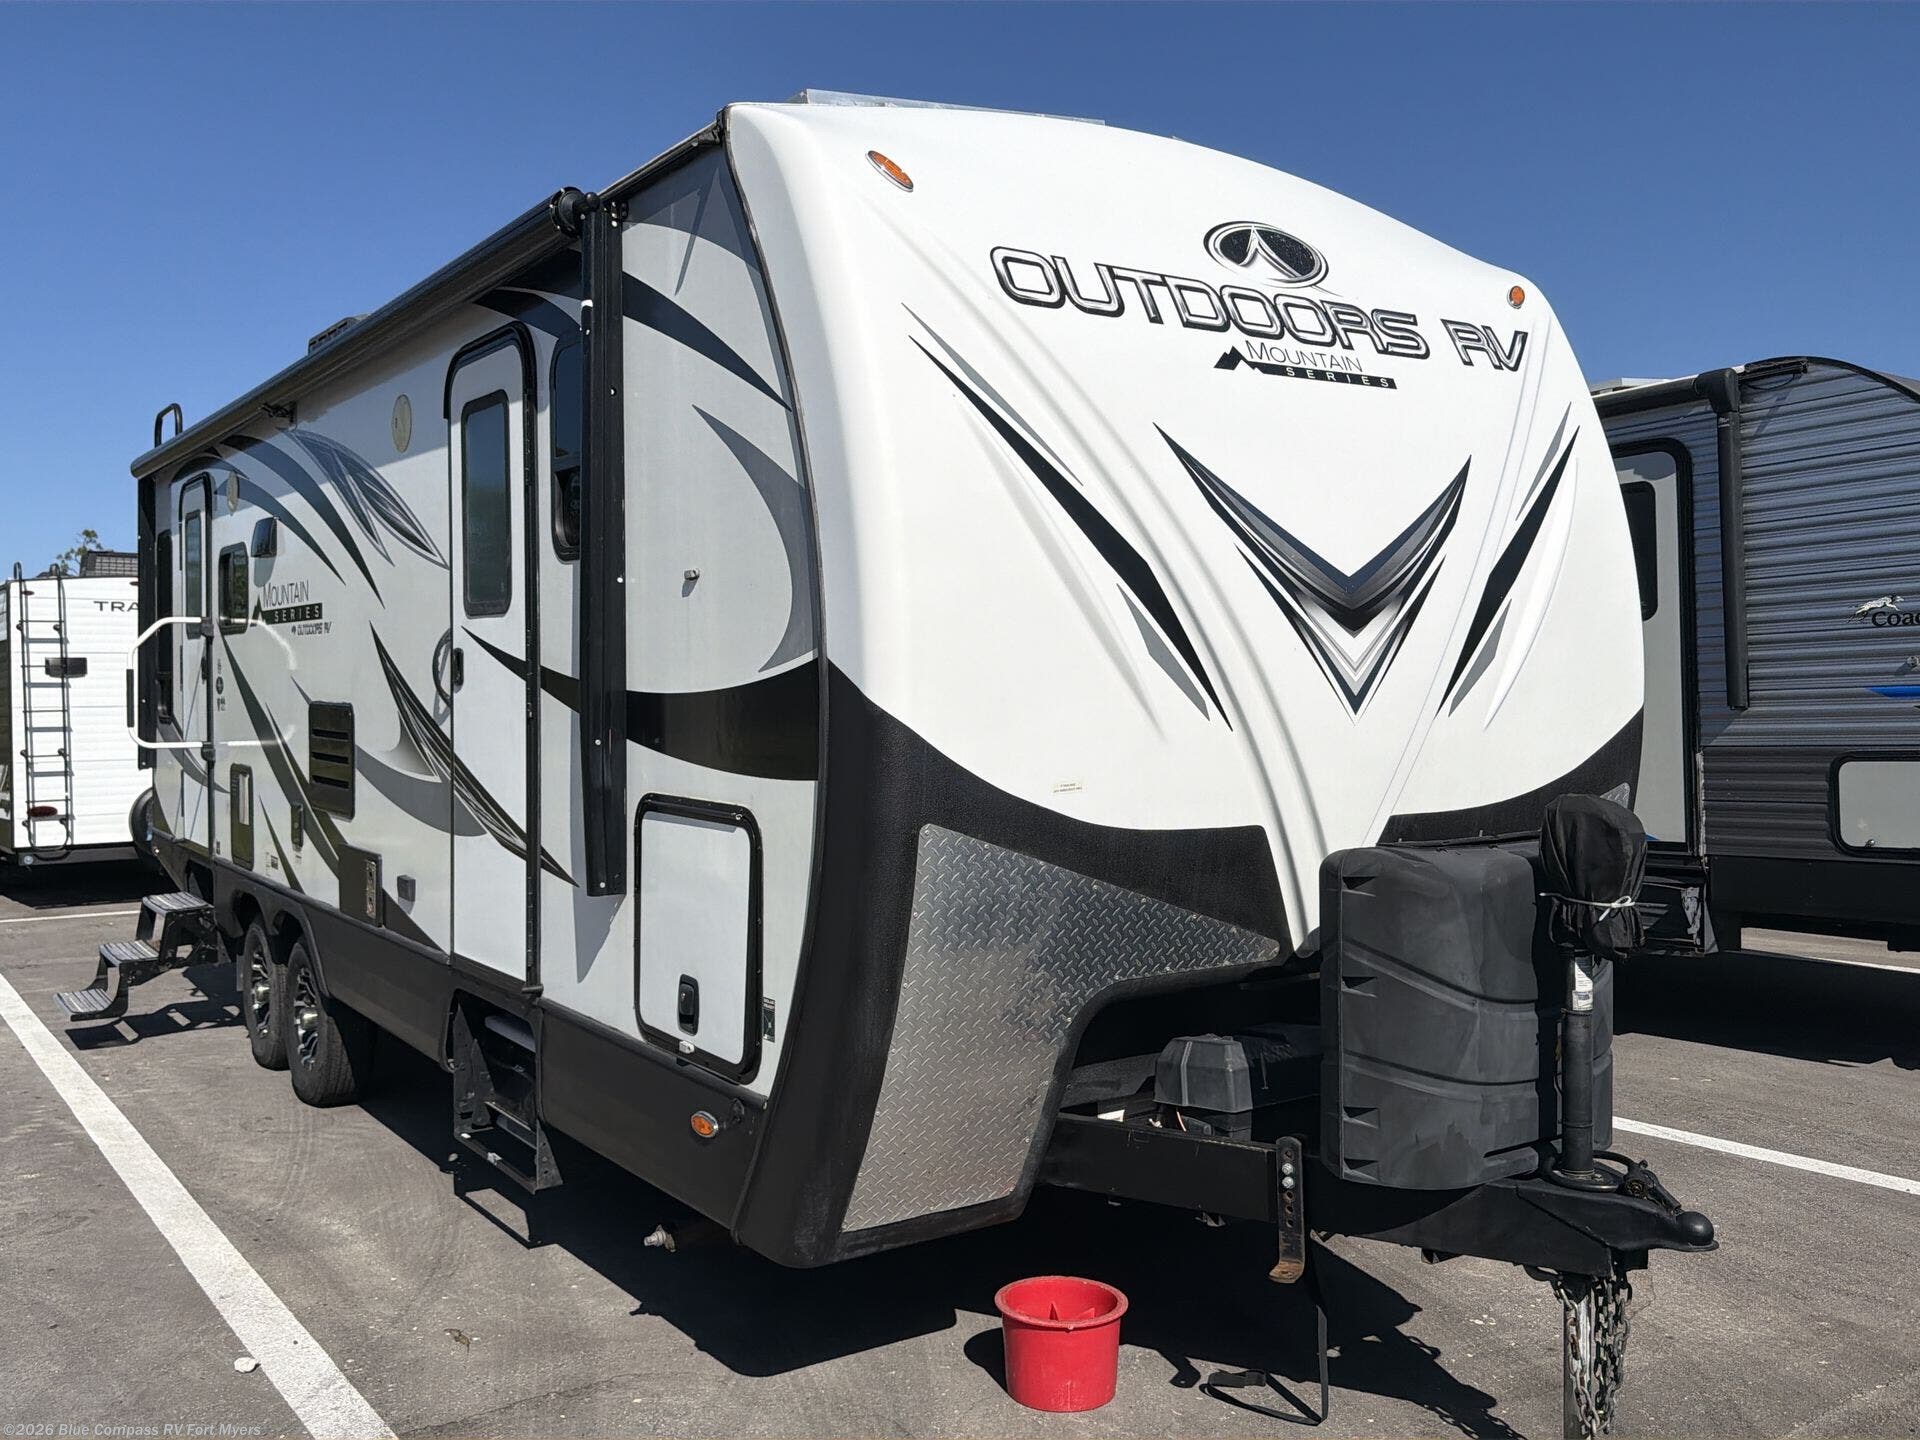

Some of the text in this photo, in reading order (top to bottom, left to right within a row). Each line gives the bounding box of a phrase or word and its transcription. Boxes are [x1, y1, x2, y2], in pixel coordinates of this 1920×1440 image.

[990, 246, 1528, 372] OUTDOORS RV
[1245, 340, 1363, 373] MOUNTAIN
[1285, 366, 1390, 388] SERIES
[93, 600, 139, 612] TRA
[262, 580, 309, 608] MOUNTAIN
[274, 605, 320, 622] SERIES
